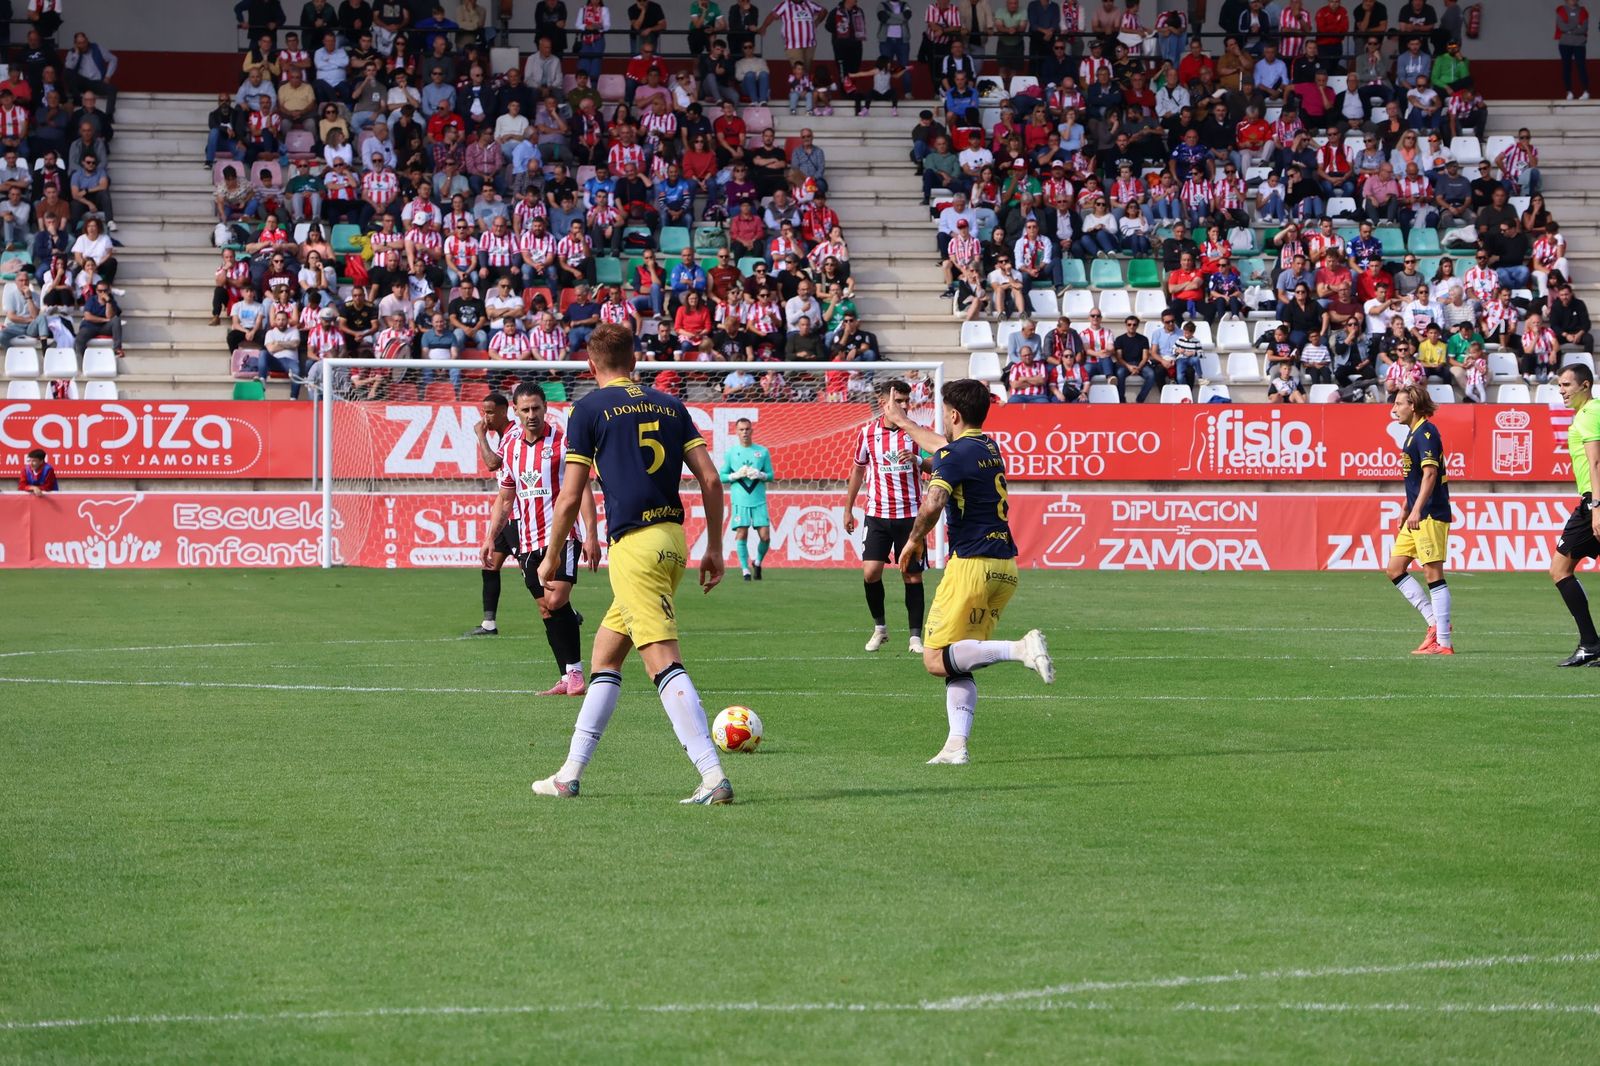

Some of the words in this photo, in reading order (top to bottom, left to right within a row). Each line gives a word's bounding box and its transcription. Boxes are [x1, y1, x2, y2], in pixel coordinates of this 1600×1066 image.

[982, 431, 1037, 453] RO
[1045, 424, 1161, 454] ÓPTICO
[1216, 409, 1312, 452] fisio
[121, 454, 131, 465] Y
[138, 454, 233, 465] JAMONES
[638, 419, 666, 475] 5
[1217, 441, 1327, 474] readapt
[1001, 454, 1105, 476] BERTO
[1551, 462, 1573, 475] AY
[1098, 538, 1271, 571] ZAMORA
